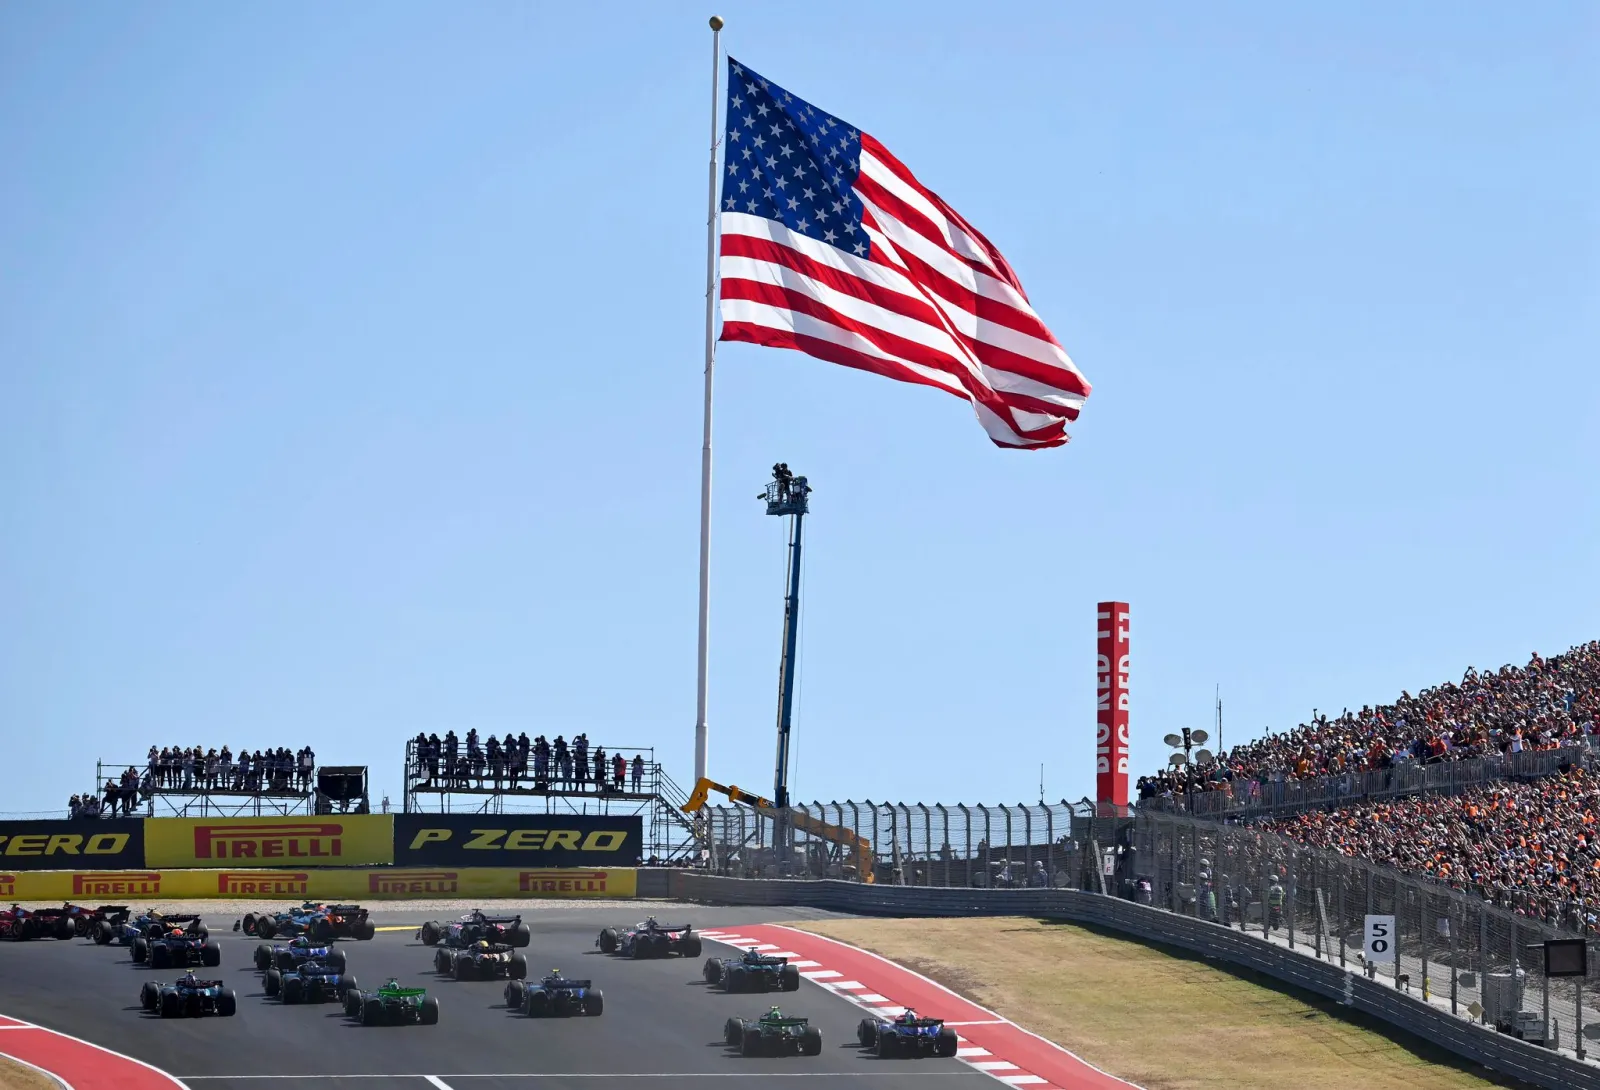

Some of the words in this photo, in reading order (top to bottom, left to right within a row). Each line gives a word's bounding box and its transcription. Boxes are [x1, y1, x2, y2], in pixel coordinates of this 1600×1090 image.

[0, 834, 130, 855] ERO
[194, 824, 343, 859] PIRELLI
[409, 829, 452, 849] P
[463, 829, 628, 851] ZERO
[73, 874, 161, 895] PIRELLI
[218, 873, 308, 893] PIRELLI
[369, 872, 458, 893] PIRELLI
[519, 871, 607, 892] PIRELLI
